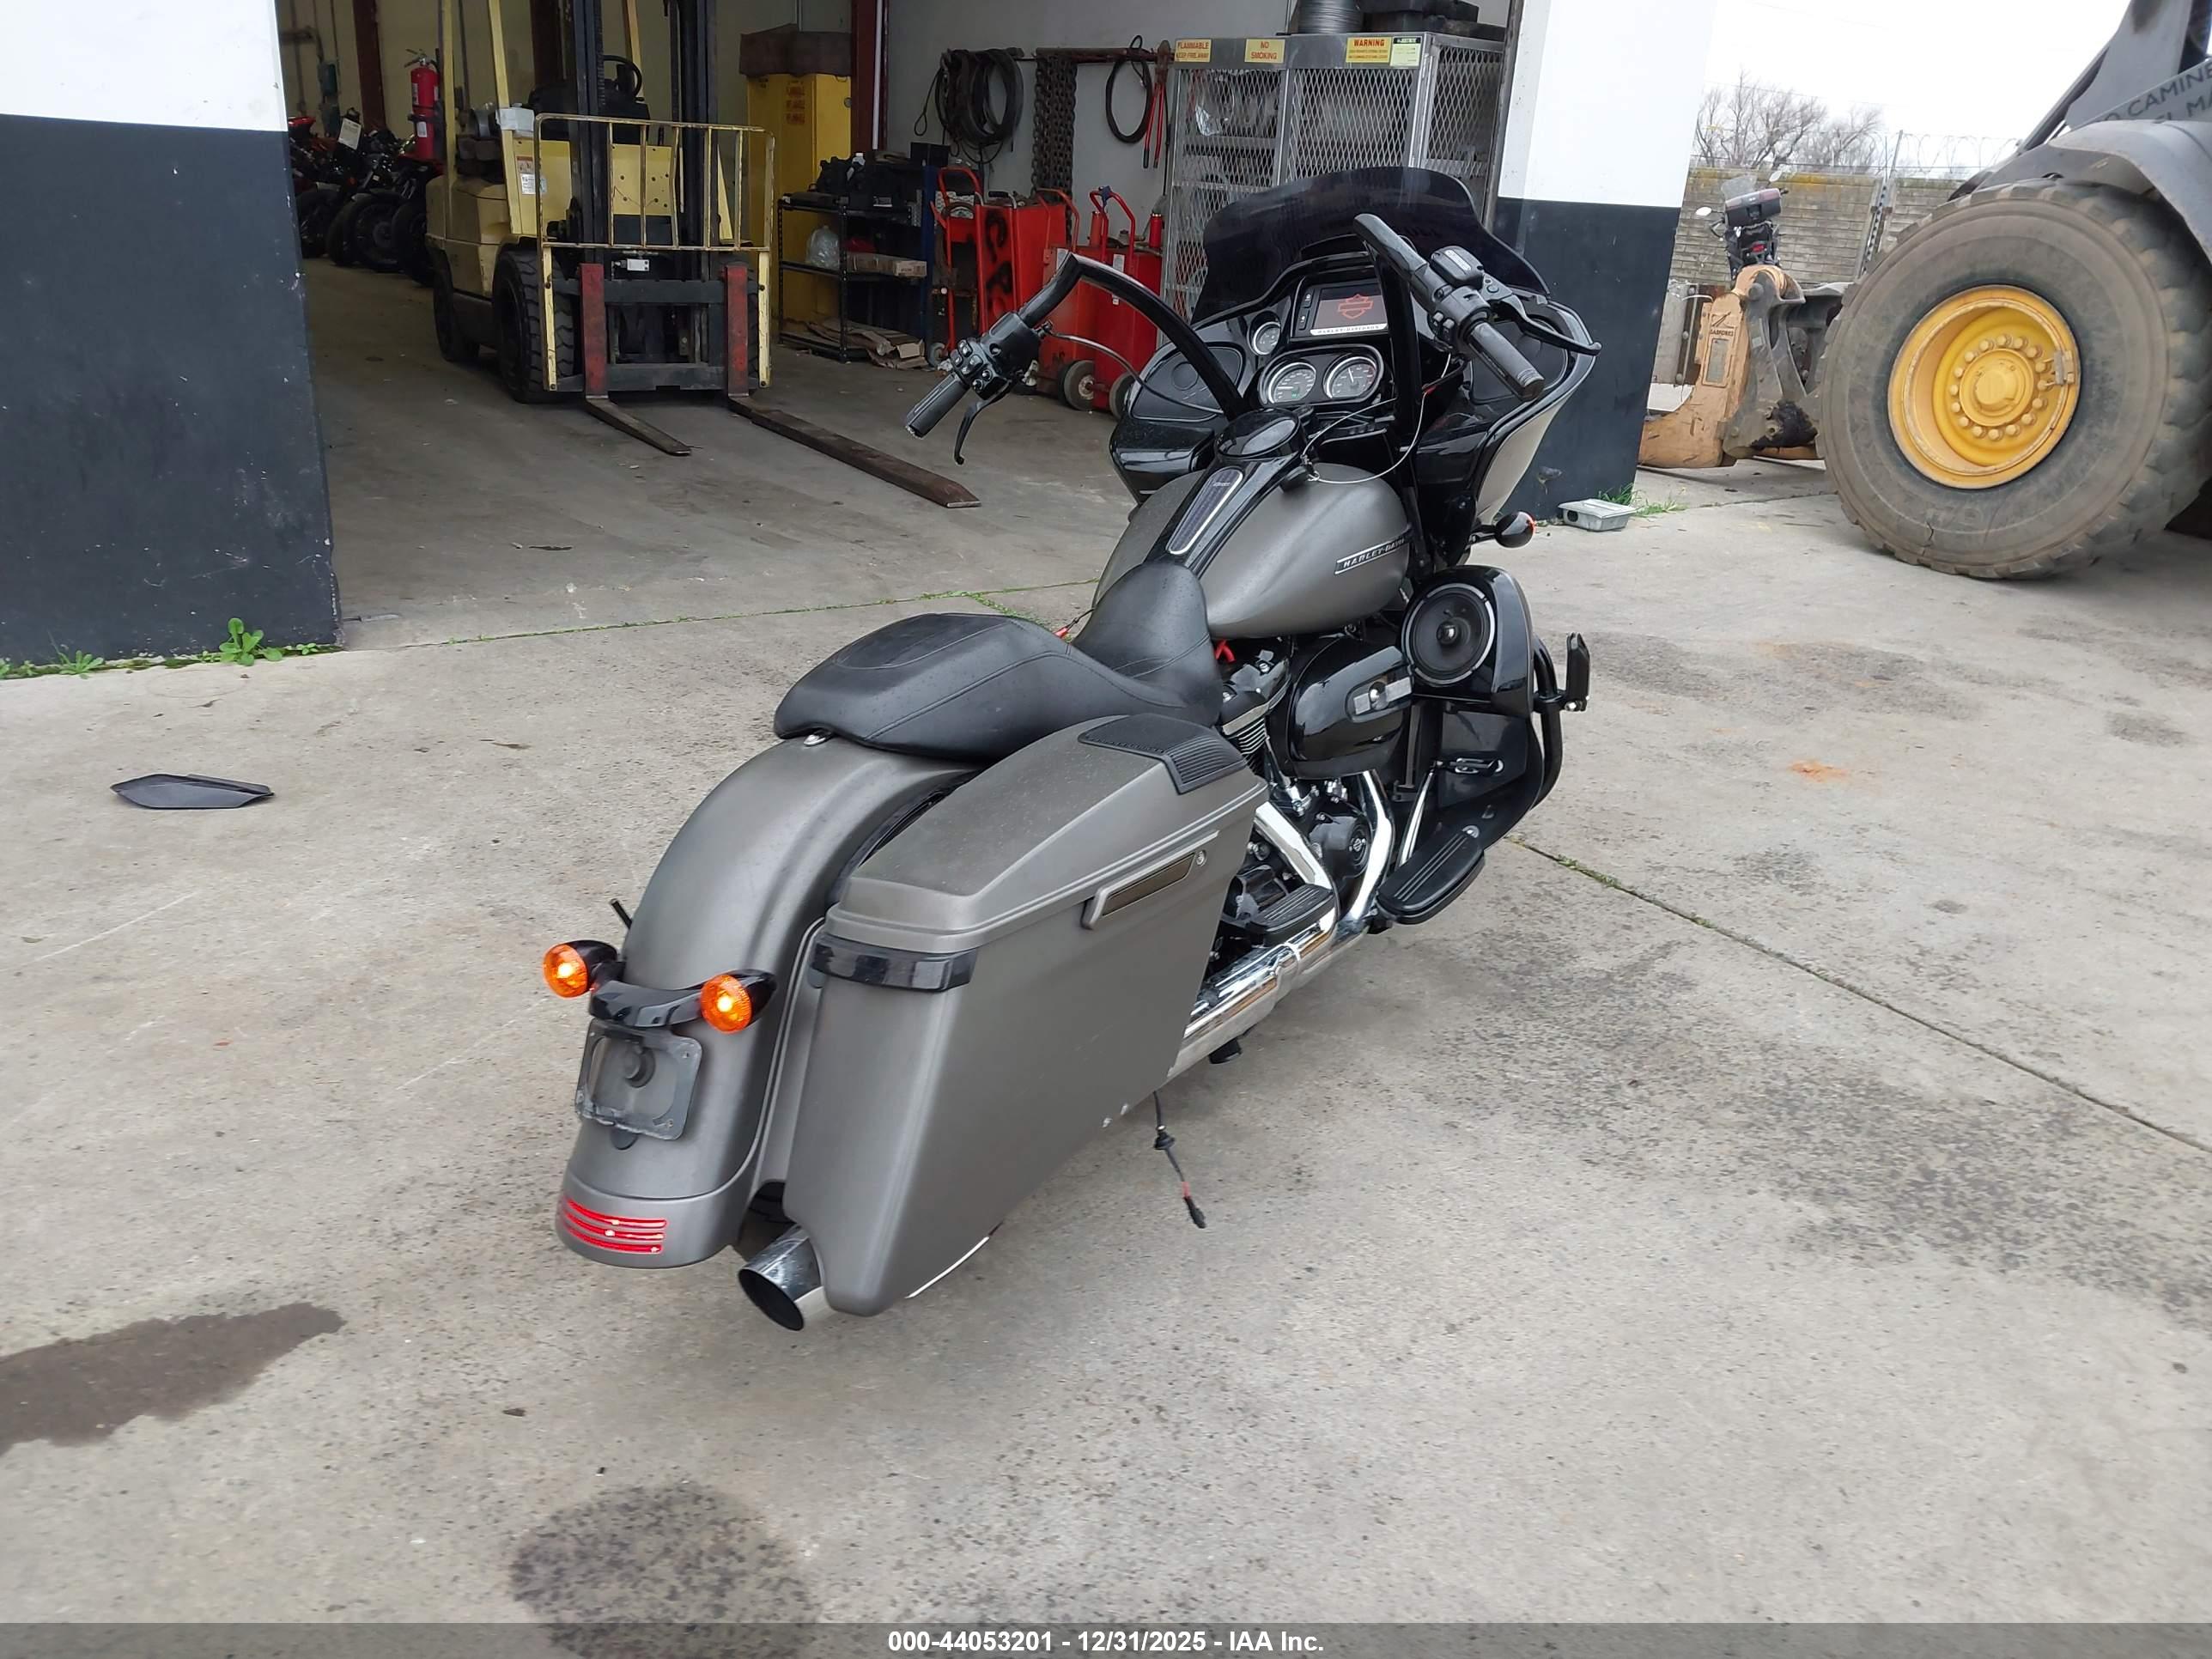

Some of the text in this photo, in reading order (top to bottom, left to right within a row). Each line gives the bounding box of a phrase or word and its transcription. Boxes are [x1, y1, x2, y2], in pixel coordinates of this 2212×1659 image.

[1177, 41, 1210, 50] FLAMMABLE
[1260, 40, 1269, 49] NO
[1250, 52, 1278, 60] SMOKING
